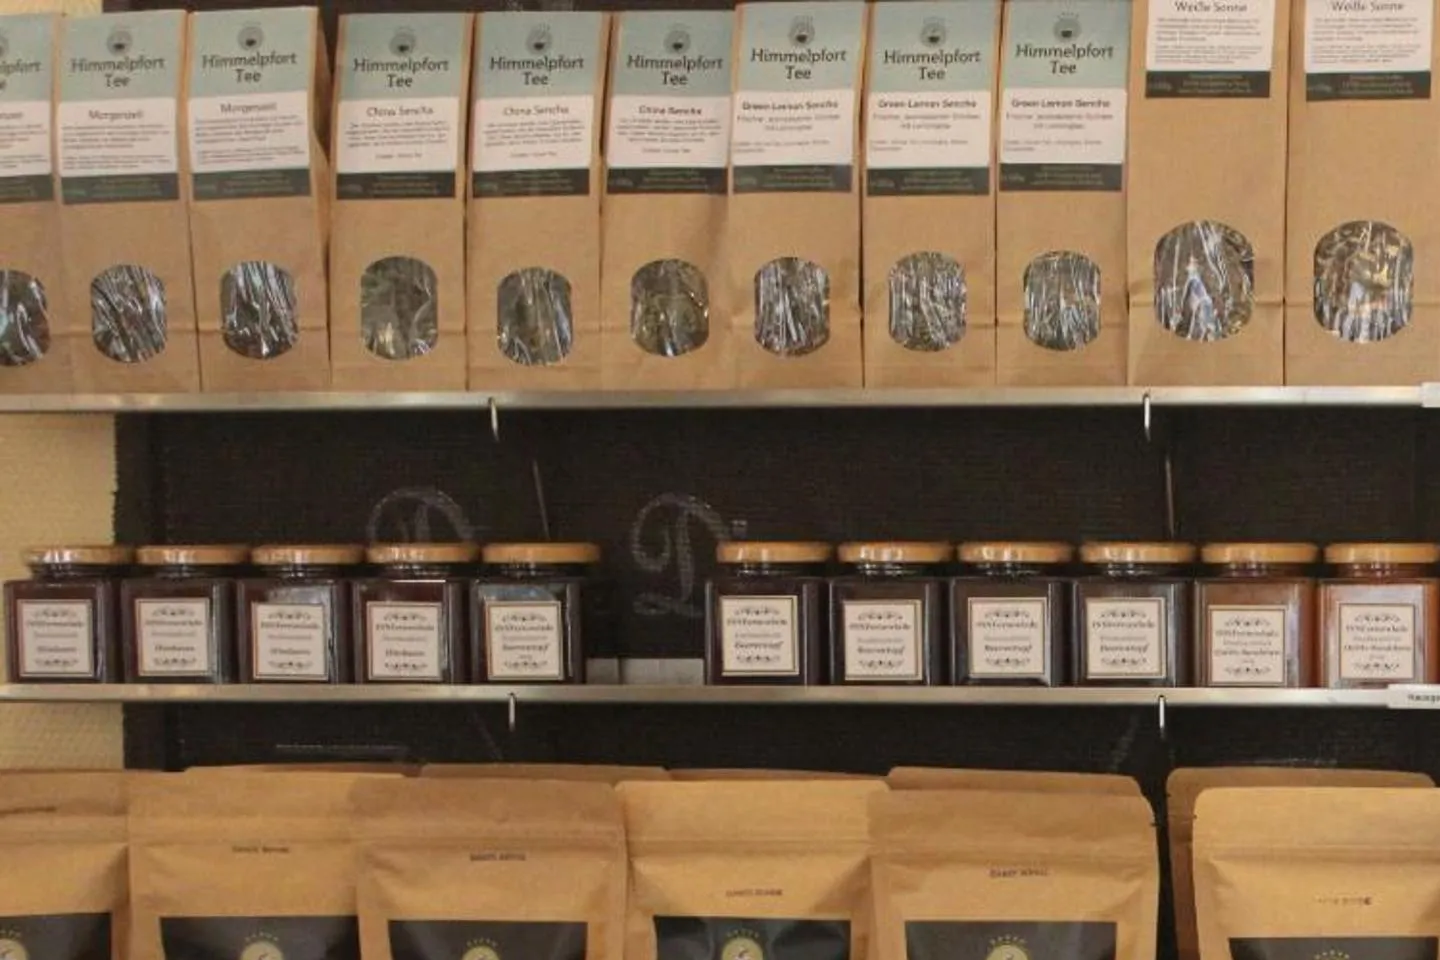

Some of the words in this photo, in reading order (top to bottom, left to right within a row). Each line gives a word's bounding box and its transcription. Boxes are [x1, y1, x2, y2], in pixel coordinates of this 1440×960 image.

[1217, 0, 1248, 13] Sonne
[1370, 1, 1405, 12] Sonne
[751, 48, 847, 65] Himmelpfort
[883, 48, 981, 66] Himmelpfort
[1015, 43, 1114, 61] Himmelpfort
[202, 51, 297, 70] Himmelpfort
[353, 58, 449, 75] Himmelpfort
[489, 55, 585, 73] Himmelpfort
[626, 54, 723, 71] Himmelpfort
[1050, 60, 1077, 75] Tee
[235, 69, 262, 83] Tee
[523, 72, 549, 86] Tee
[661, 71, 689, 86] Tee
[785, 65, 812, 80] Tee
[918, 66, 946, 81] Tee
[104, 74, 131, 88] Tee
[387, 75, 413, 88] Tee
